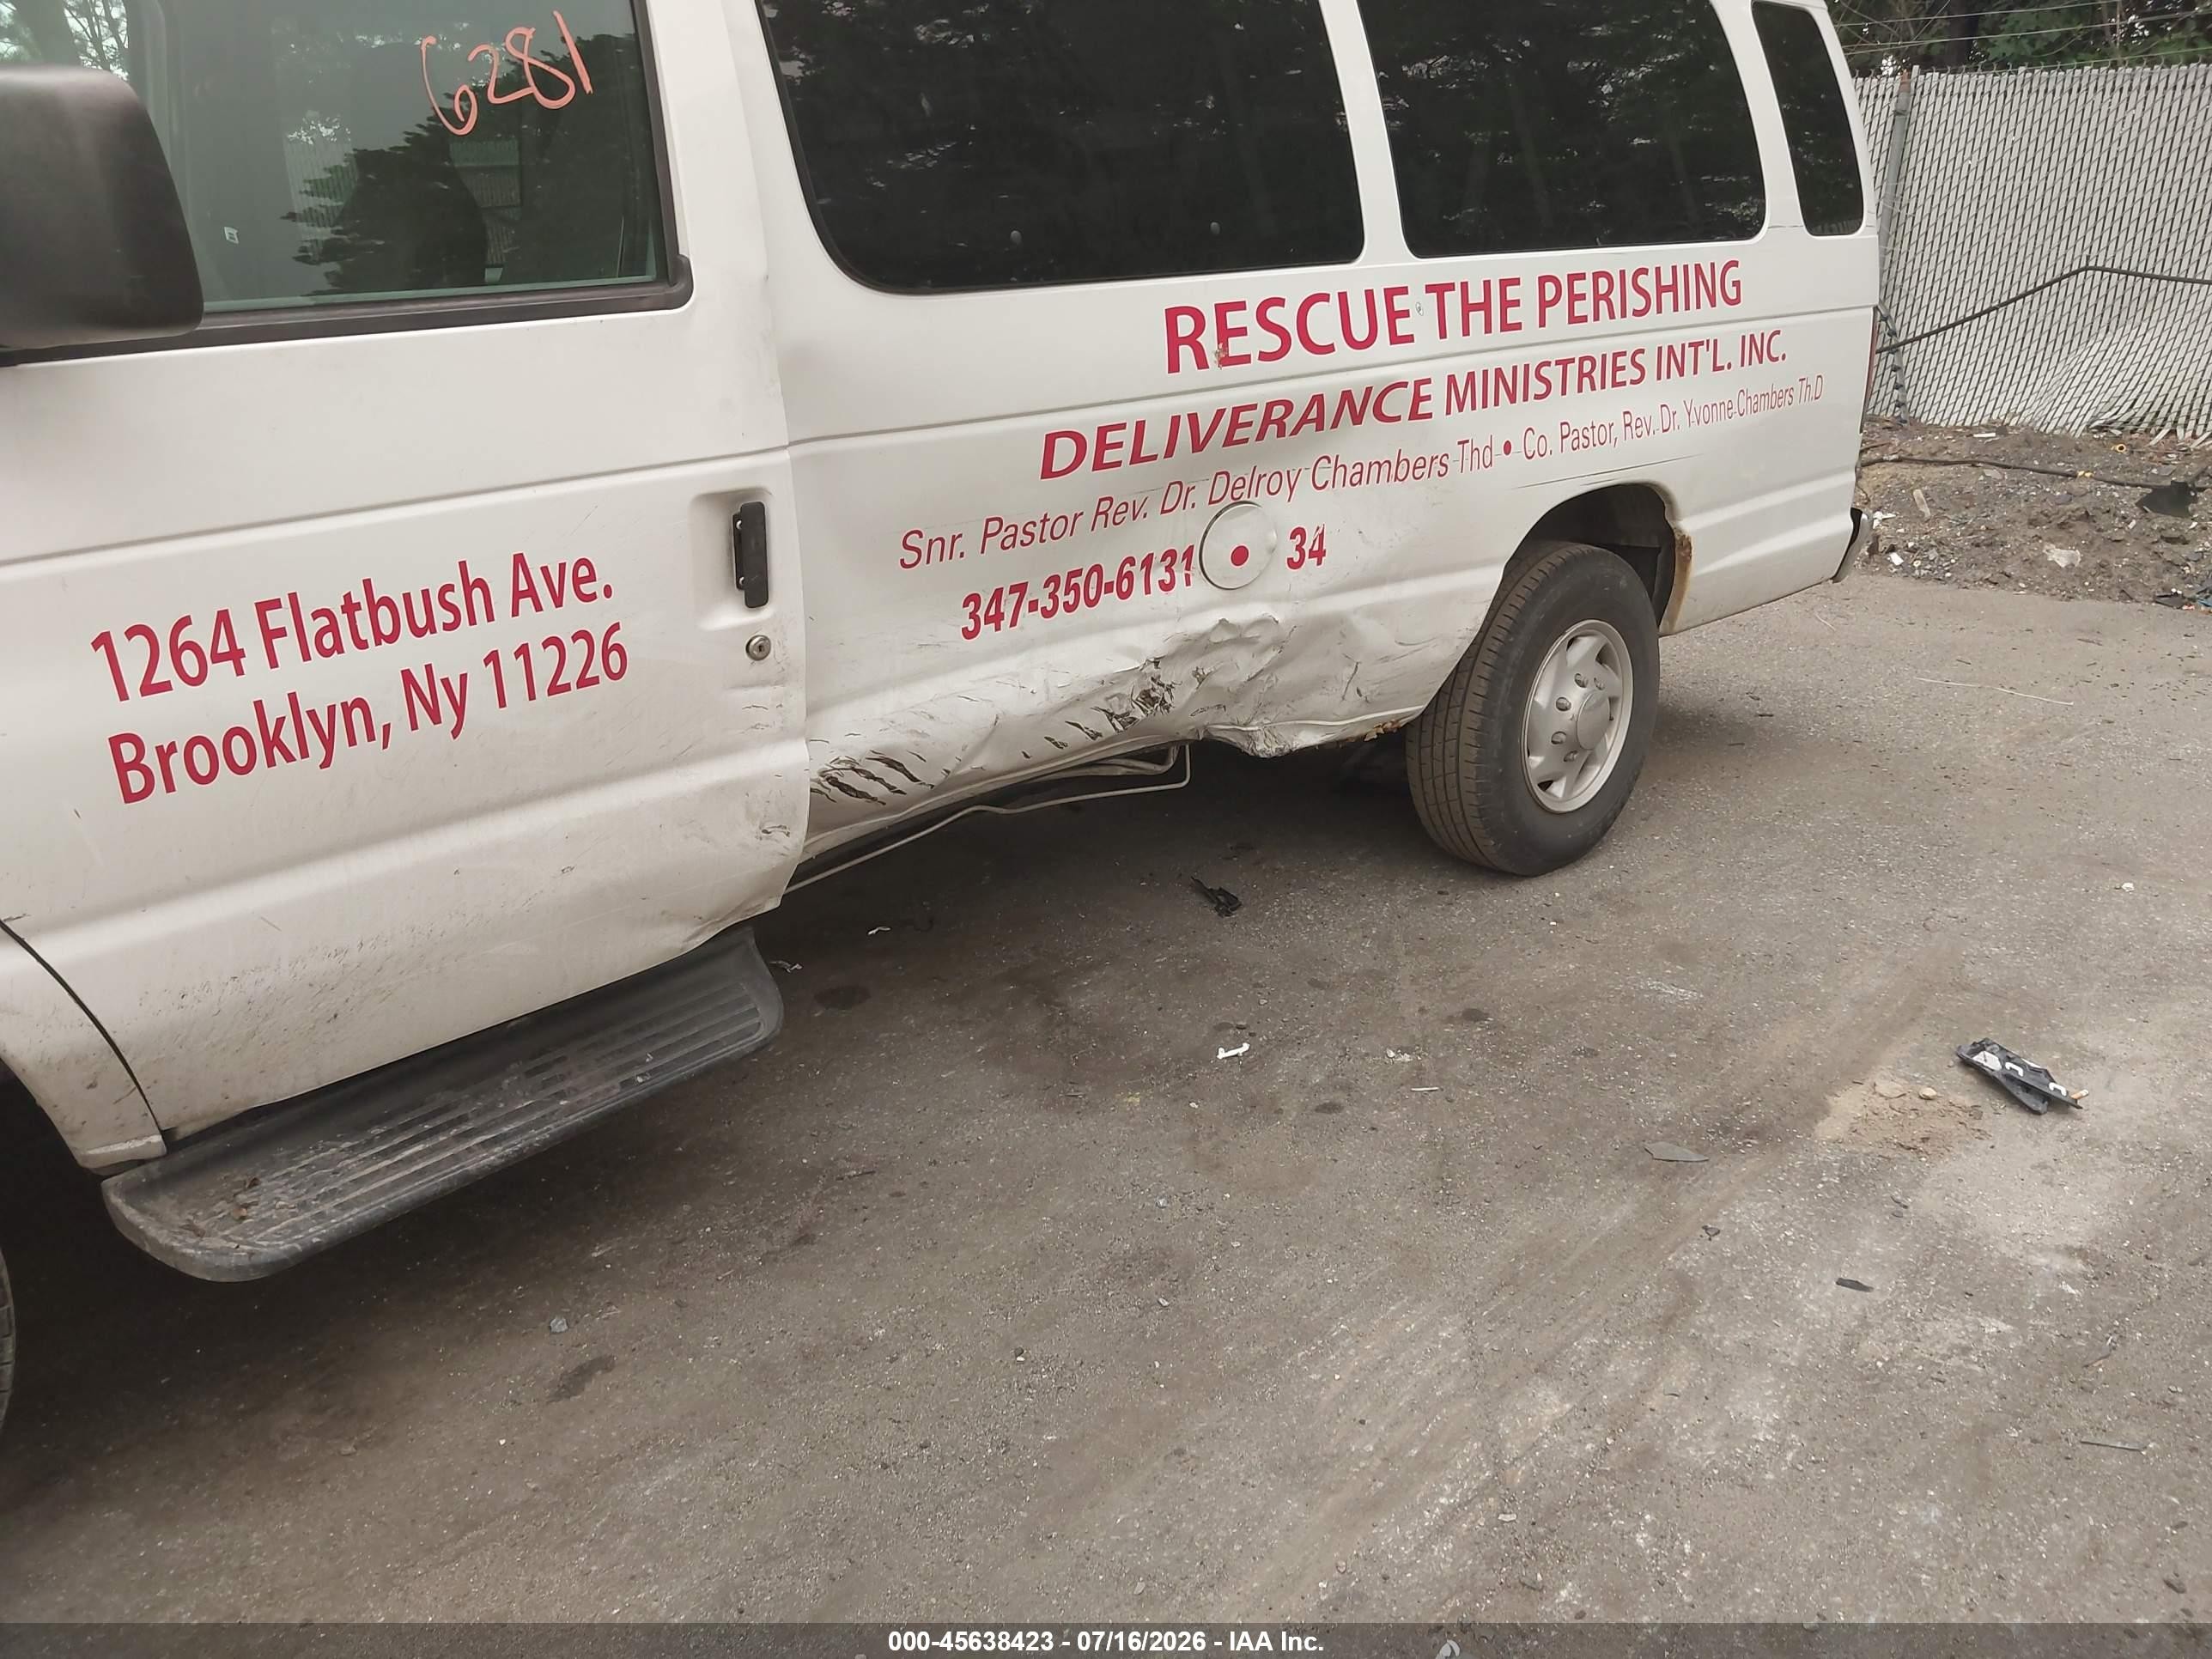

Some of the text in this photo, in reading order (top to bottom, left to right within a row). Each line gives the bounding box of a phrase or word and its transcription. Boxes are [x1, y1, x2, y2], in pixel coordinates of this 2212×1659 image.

[421, 10, 594, 135] 6281
[1164, 258, 1744, 375] RESCUE THE PERISHING
[898, 374, 1824, 571] Snr. Pastor Rev. Dr. Delroy Chambers Thd Co. Pastor, Rev. Dr. Yvonne Chambers Th.D
[1039, 328, 1787, 481] DELIVERANCE MINISTRIES INT'L. INC.
[90, 552, 613, 702] 1264 Flatbush Ave.
[961, 524, 1327, 641] 347-350-6131 34
[107, 622, 629, 805] Brooklyn, Ny 11226
